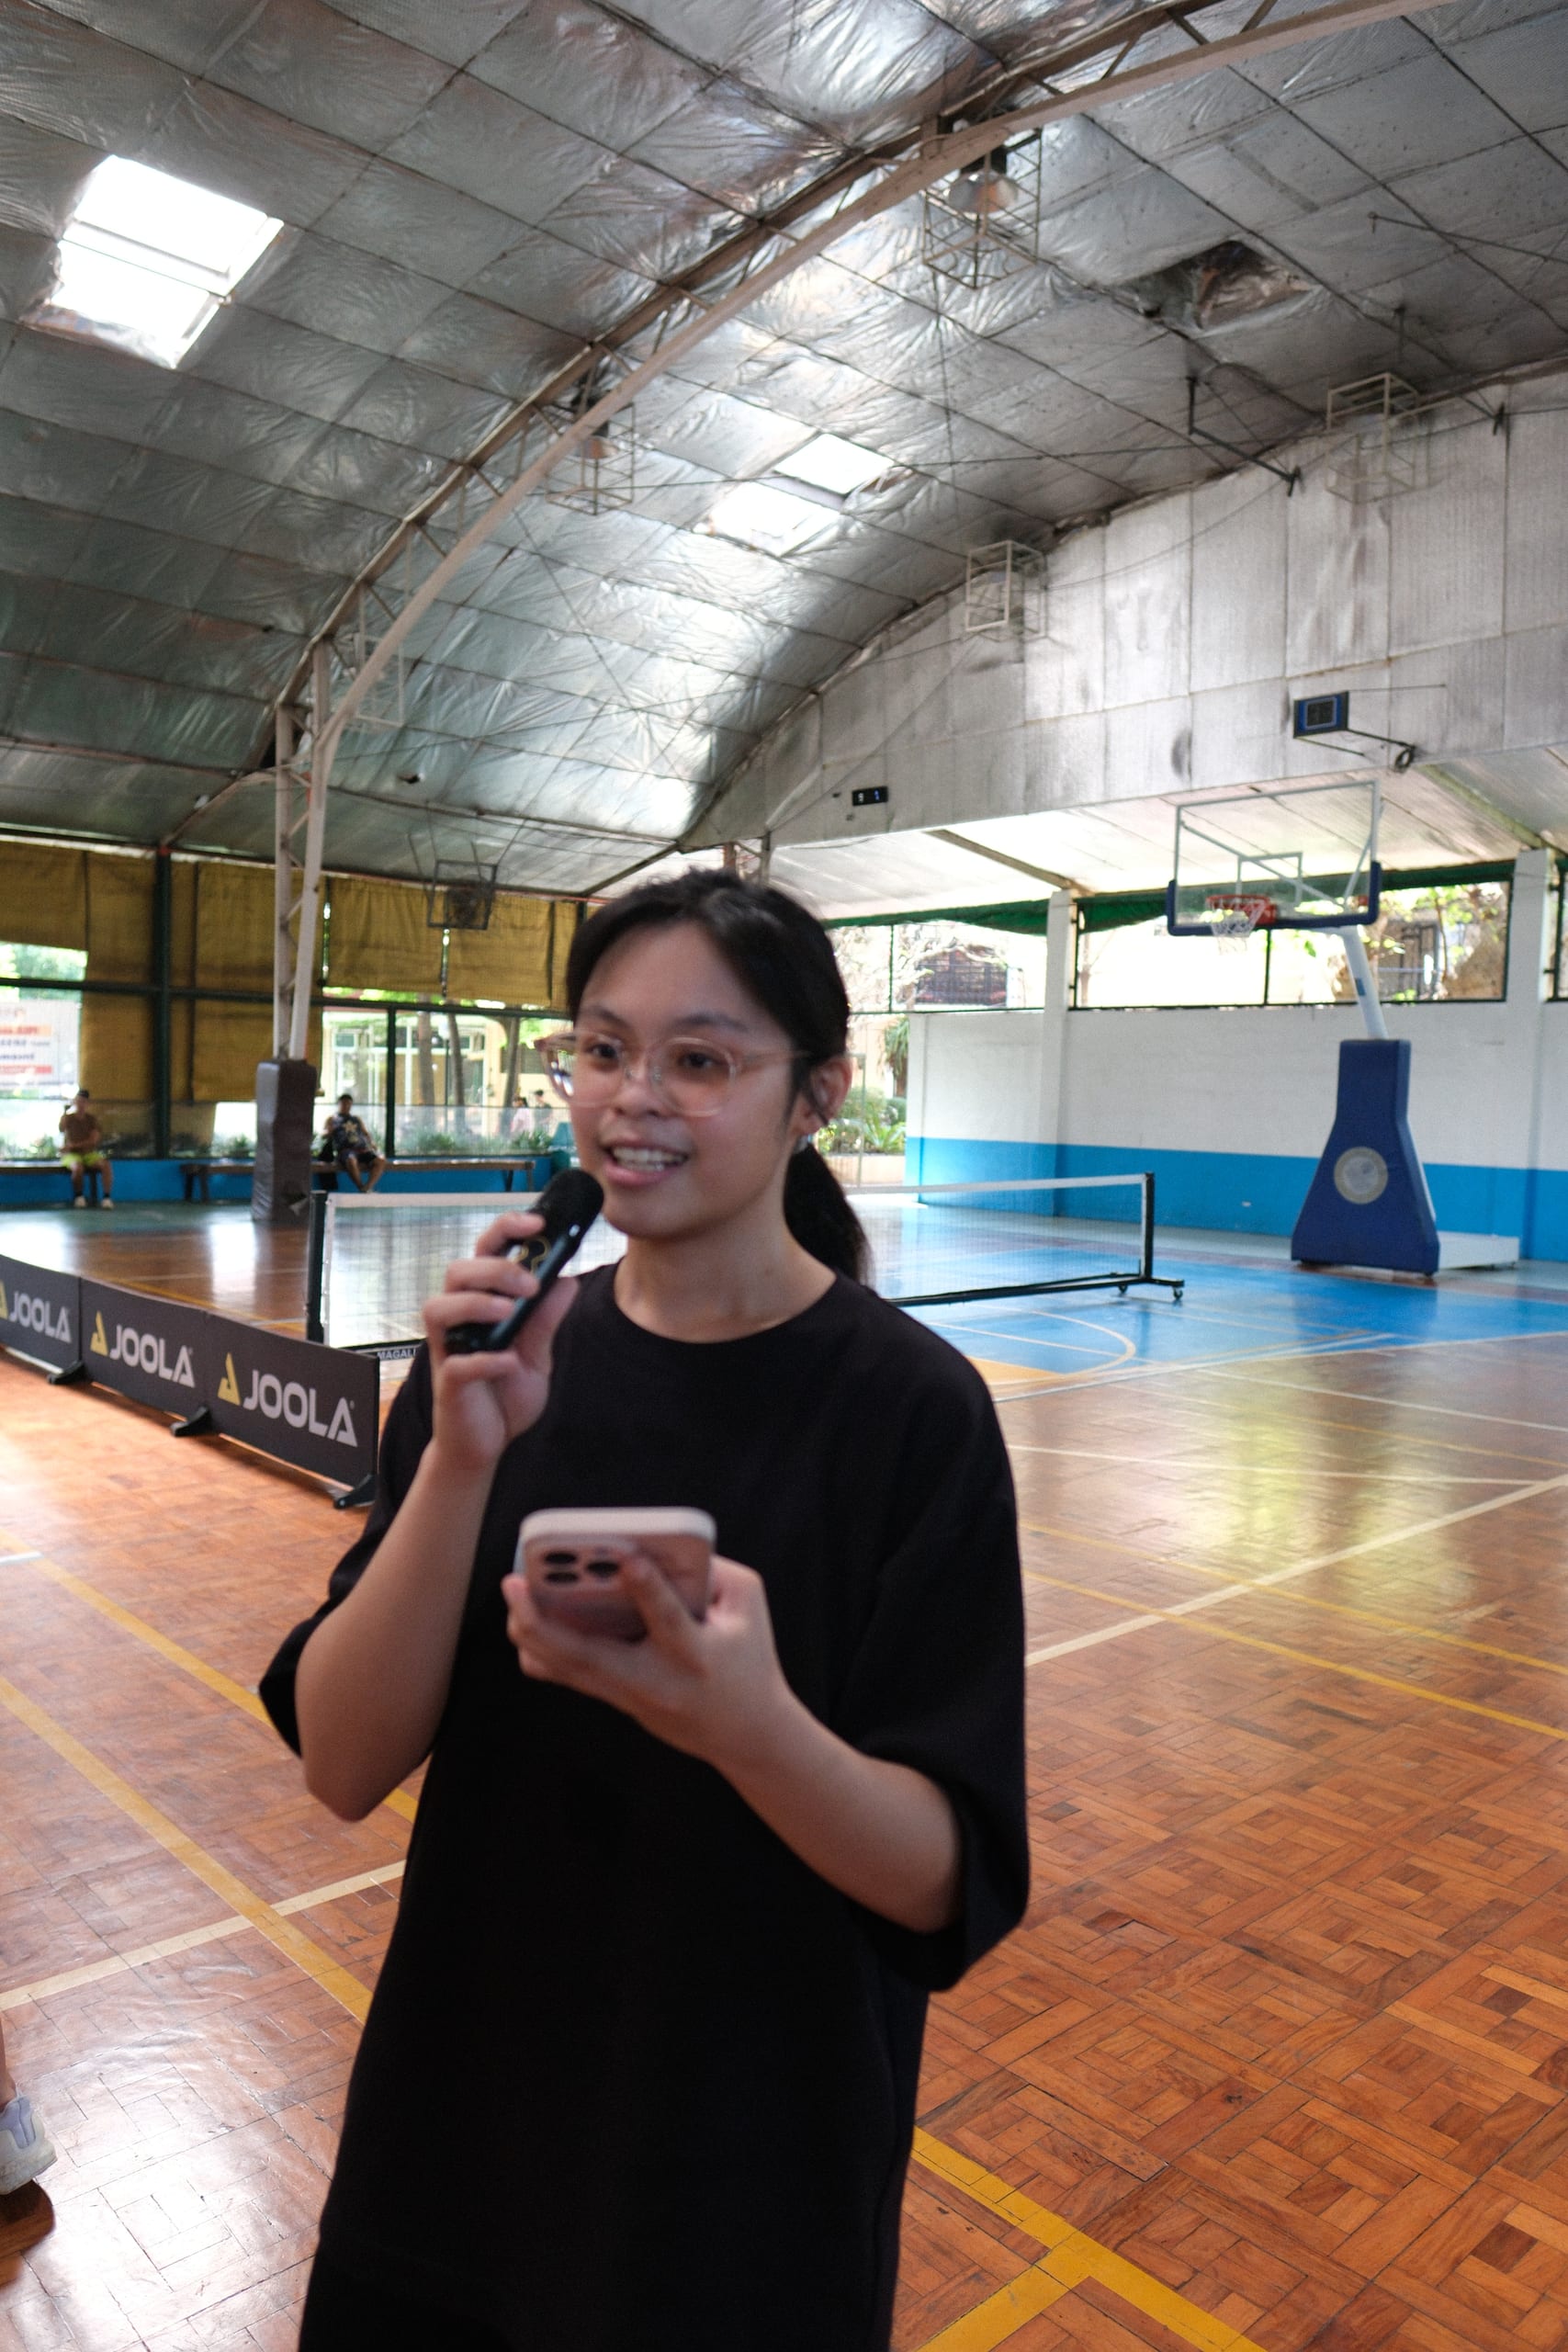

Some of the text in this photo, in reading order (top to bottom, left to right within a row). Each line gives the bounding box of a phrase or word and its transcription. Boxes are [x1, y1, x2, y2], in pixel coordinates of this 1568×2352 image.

[9, 1291, 72, 1343] JOOLA
[109, 1324, 196, 1388] JOOLA
[243, 1369, 358, 1447] JOOLA
